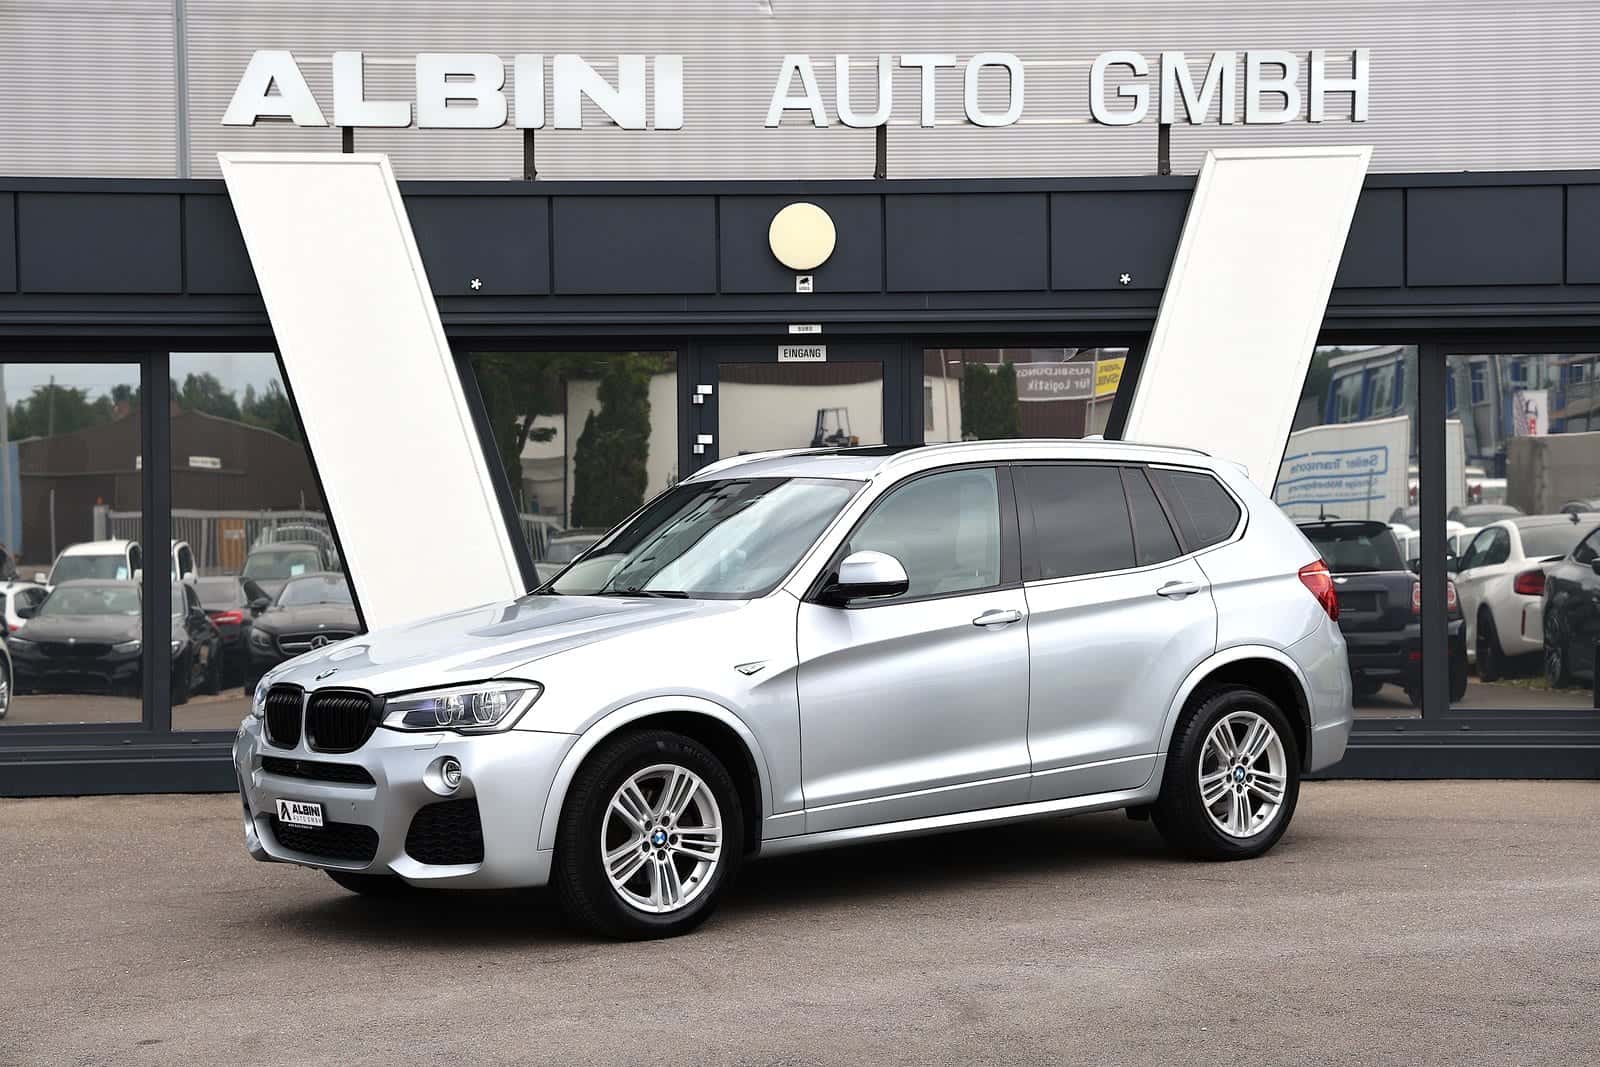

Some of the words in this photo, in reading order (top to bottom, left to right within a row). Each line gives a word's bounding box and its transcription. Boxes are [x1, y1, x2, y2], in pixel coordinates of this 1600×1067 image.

[221, 49, 685, 131] ALBINI
[764, 51, 1025, 129] AUTO
[1087, 47, 1371, 126] GMBH
[784, 348, 821, 358] EINGANG
[292, 804, 320, 816] ALBINI
